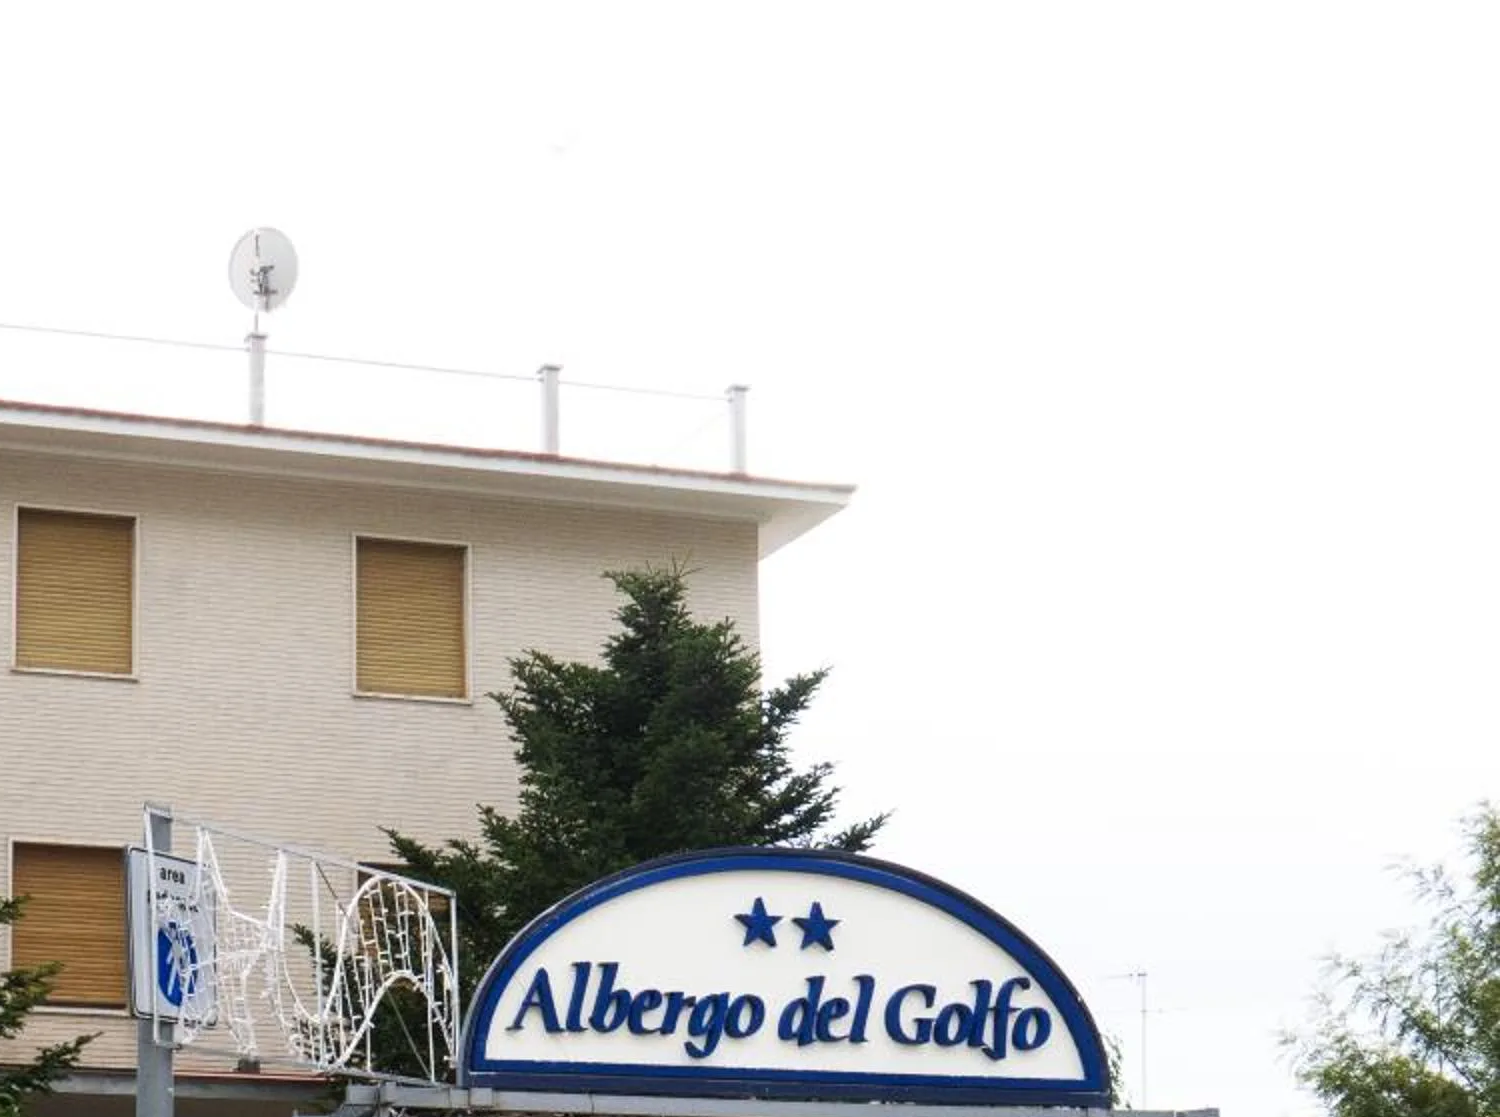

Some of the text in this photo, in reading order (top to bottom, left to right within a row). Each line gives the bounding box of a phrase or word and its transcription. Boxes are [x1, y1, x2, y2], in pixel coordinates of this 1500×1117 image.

[160, 867, 185, 884] area
[507, 962, 1052, 1060] Albergo del Golfo
